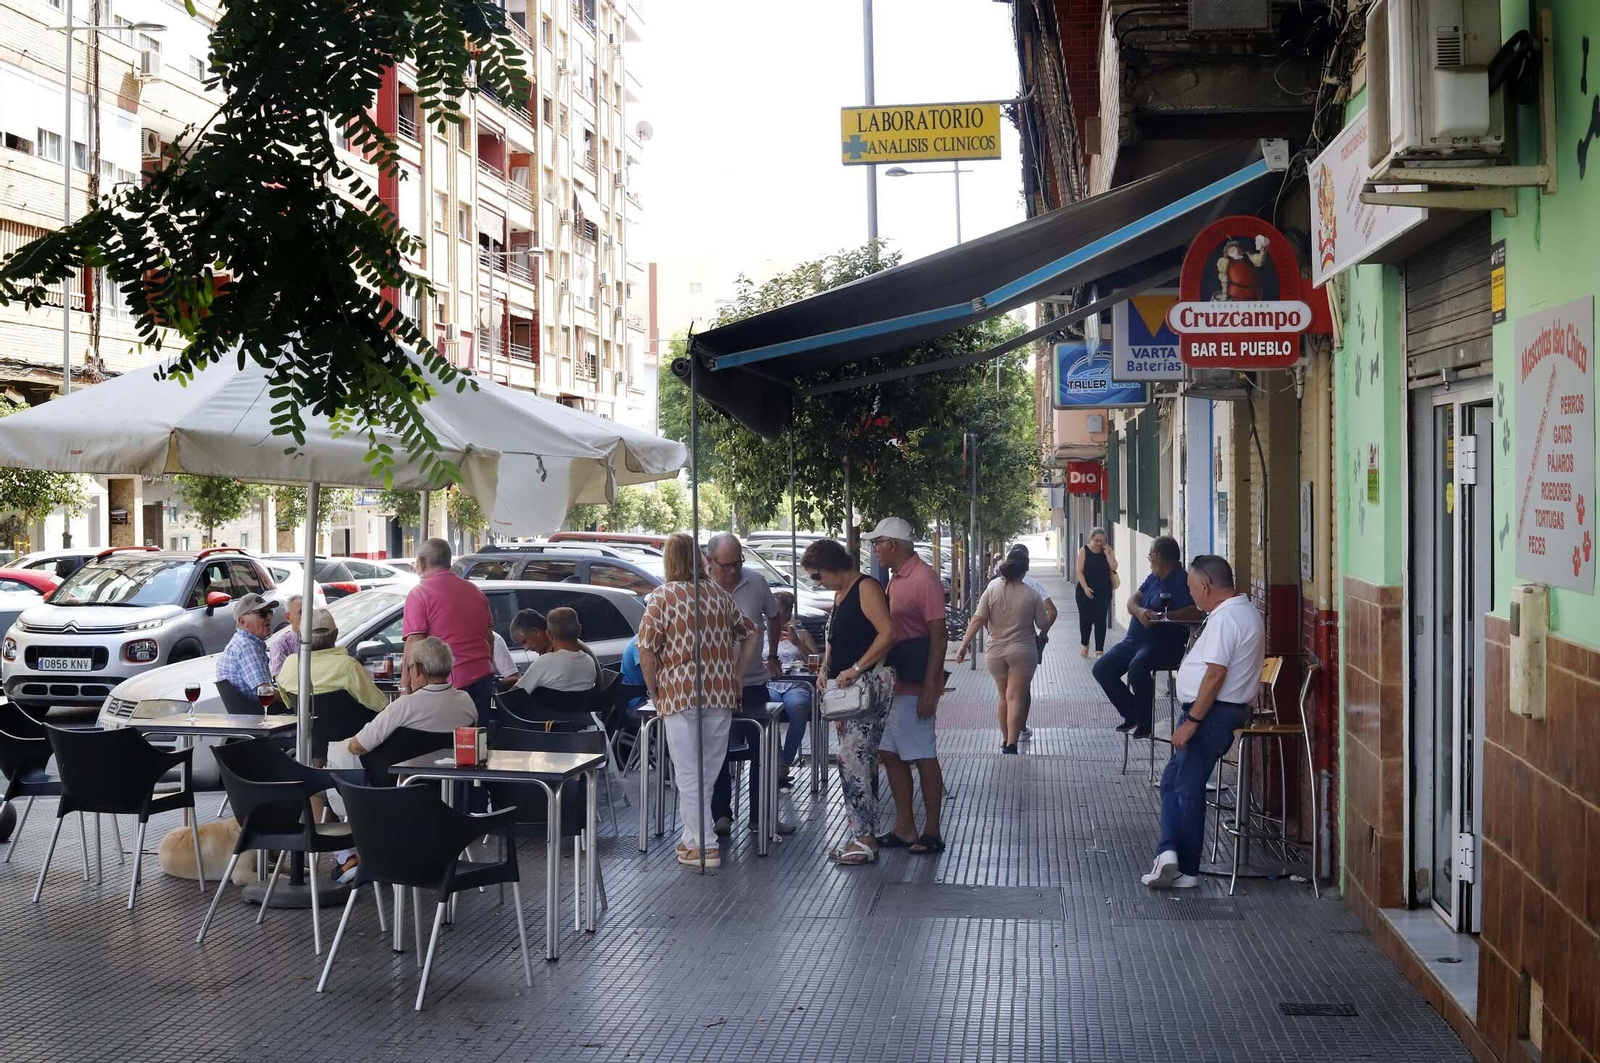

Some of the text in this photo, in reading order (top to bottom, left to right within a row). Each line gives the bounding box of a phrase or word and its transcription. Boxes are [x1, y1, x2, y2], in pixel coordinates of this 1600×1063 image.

[857, 107, 984, 133] LABORATORIO
[868, 135, 996, 155] ANALISIS CLINICOS
[1180, 306, 1301, 331] Cruzcampo
[1131, 347, 1177, 359] VARTA
[1191, 340, 1292, 357] BAR EL PUEBLO
[1522, 326, 1551, 385] Mascotas
[1553, 317, 1565, 355] Isla
[1566, 323, 1587, 375] Chica
[1127, 358, 1182, 372] Baterías
[1068, 379, 1107, 390] TALLER
[1561, 394, 1585, 415] PERROS
[1553, 424, 1572, 444] GATOS
[1547, 449, 1574, 473] PÁJAROS
[1541, 481, 1572, 502] ROEDORES
[1534, 508, 1564, 530] TORTUGAS
[1528, 535, 1546, 556] PECES
[44, 659, 89, 670] 0856 KNV
